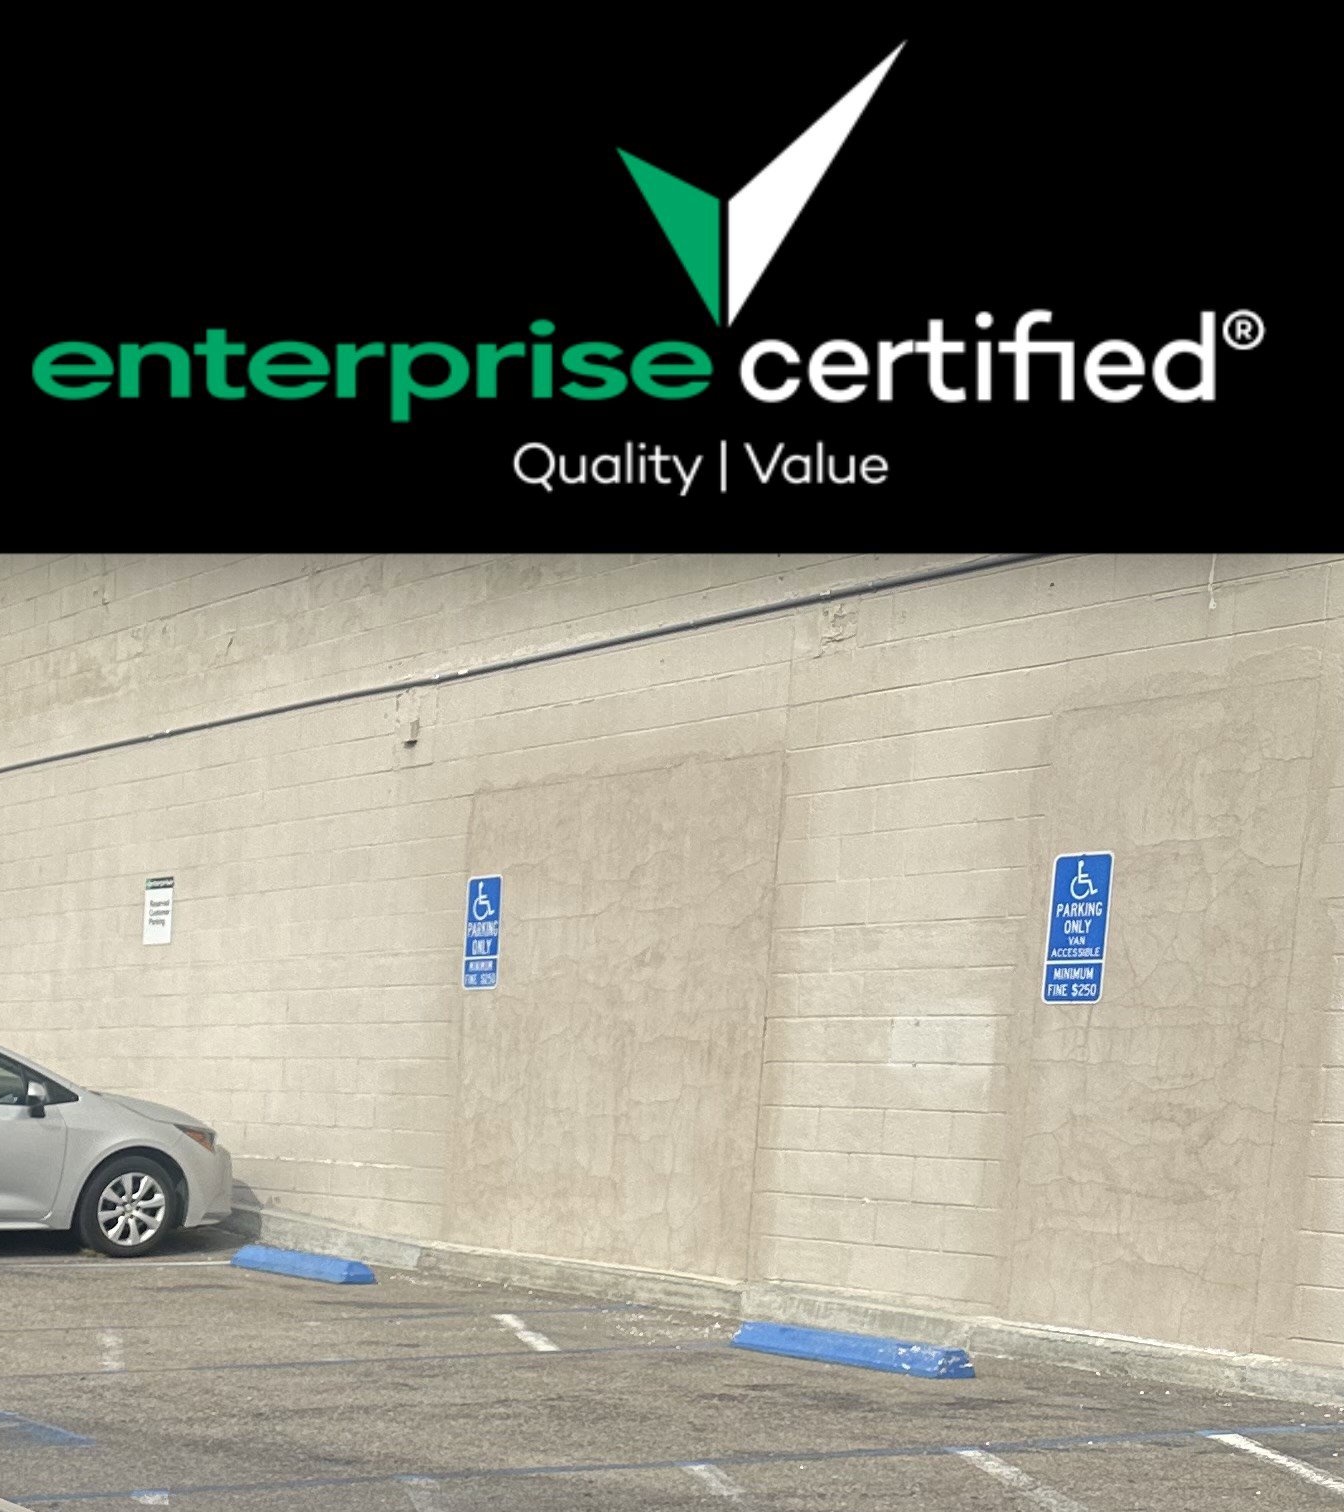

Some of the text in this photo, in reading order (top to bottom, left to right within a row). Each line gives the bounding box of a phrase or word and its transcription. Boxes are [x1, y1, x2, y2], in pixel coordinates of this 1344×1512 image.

[1056, 902, 1103, 918] PARKING
[1064, 919, 1092, 934] ONLY
[1069, 936, 1086, 945] VAN
[1050, 947, 1100, 958] ACCESSIBLE
[1053, 967, 1094, 980] MINIMUM
[1047, 983, 1097, 997] FINE $250
